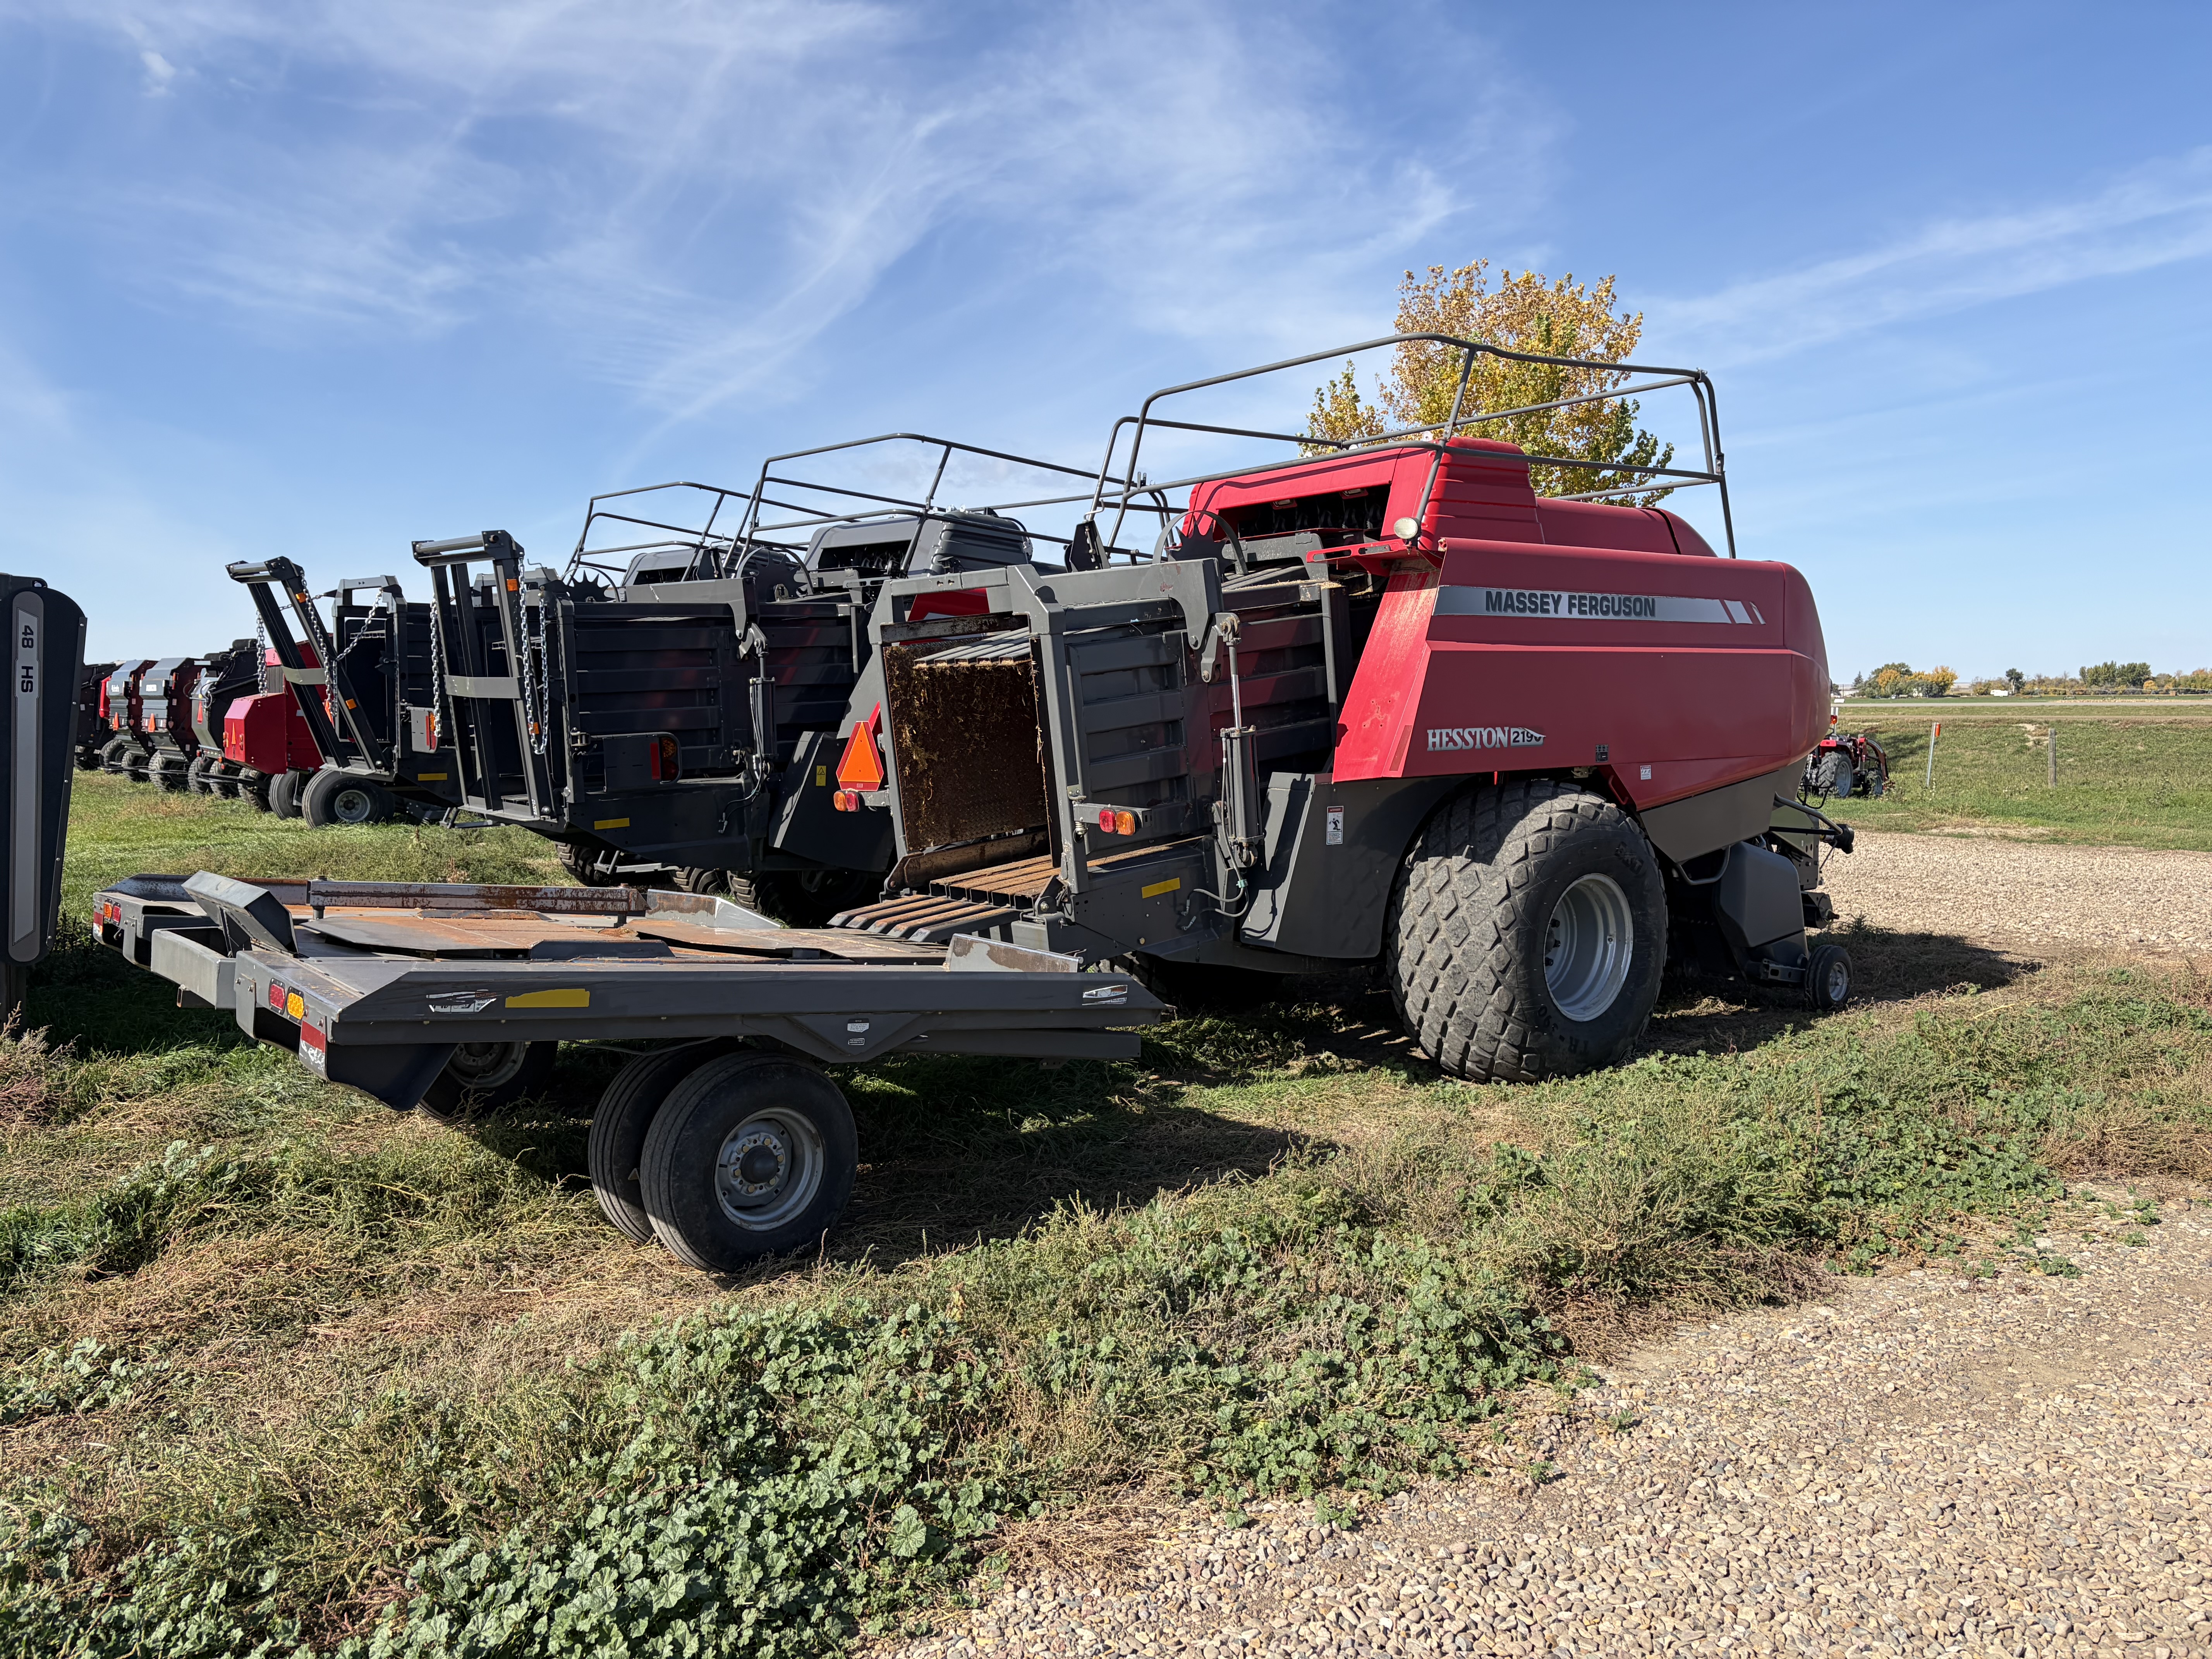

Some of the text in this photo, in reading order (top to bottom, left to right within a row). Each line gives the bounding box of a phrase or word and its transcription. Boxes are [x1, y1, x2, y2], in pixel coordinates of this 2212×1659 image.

[1486, 591, 1656, 617] MASSEY FERGUSON
[21, 625, 34, 692] 48 HS
[1427, 727, 1509, 751] HESSTON
